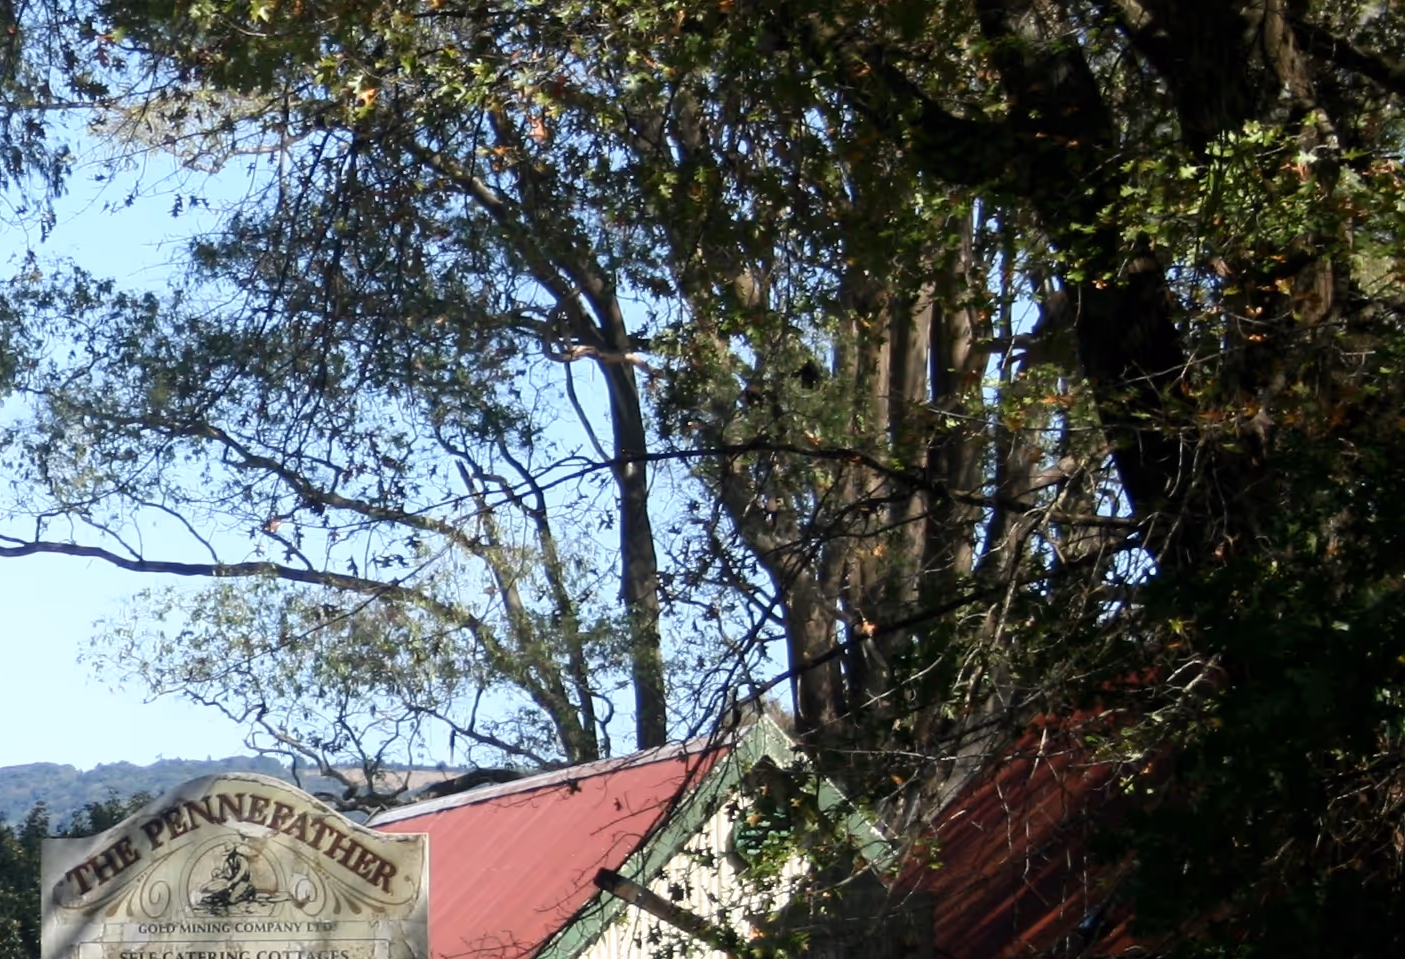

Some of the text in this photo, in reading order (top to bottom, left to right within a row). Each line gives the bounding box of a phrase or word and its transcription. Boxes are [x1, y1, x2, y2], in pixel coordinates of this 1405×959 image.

[66, 792, 398, 896] THE PENNEFATHER
[138, 922, 175, 934] GOLD
[179, 922, 230, 934] MINING
[235, 921, 302, 933] COMPANY
